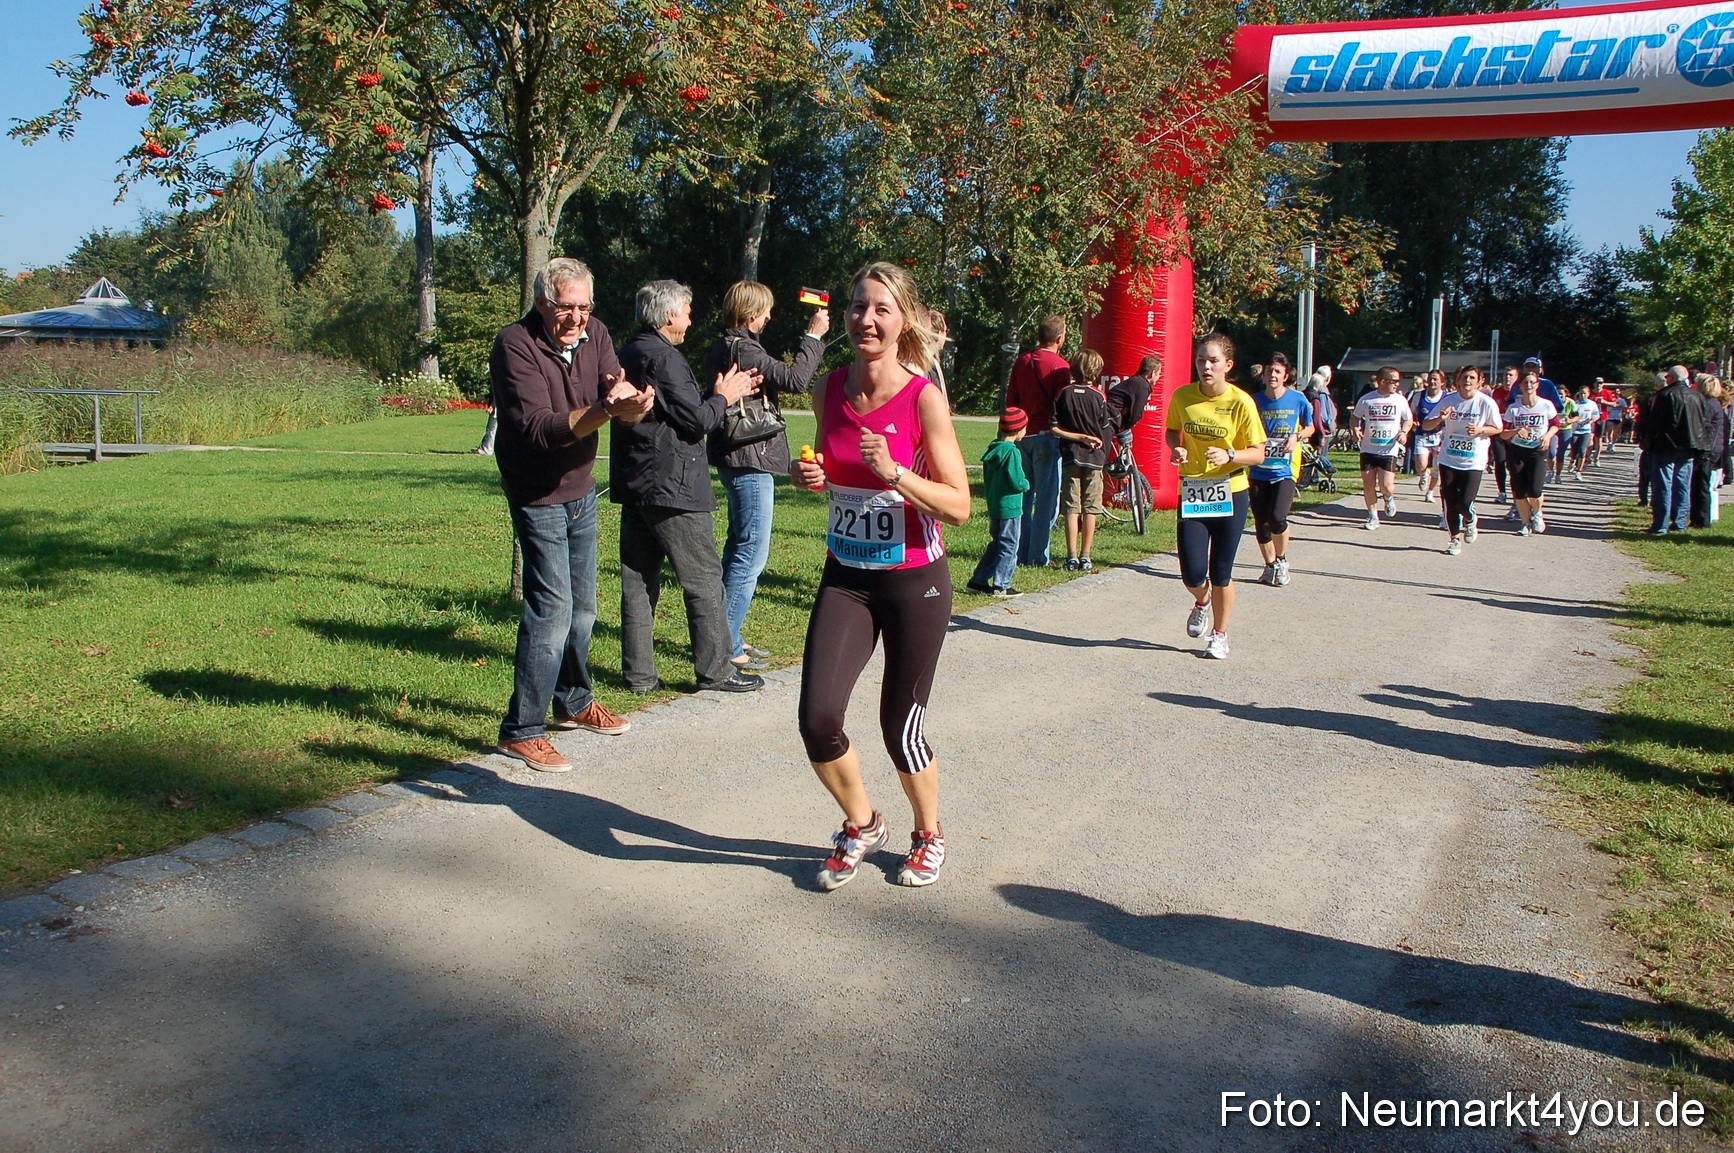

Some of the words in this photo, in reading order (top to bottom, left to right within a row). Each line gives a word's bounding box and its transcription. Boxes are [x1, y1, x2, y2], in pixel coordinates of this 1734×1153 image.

[1284, 29, 1666, 94] slackstar
[1382, 405, 1397, 415] 97.1
[1529, 415, 1545, 425] 97.1
[1371, 429, 1392, 438] 2183
[1264, 445, 1285, 458] 525
[1449, 440, 1473, 451] 3238
[1187, 485, 1226, 503] 3125
[1193, 504, 1223, 513] Denise
[833, 505, 894, 541] 2219
[834, 537, 892, 560] Manuela
